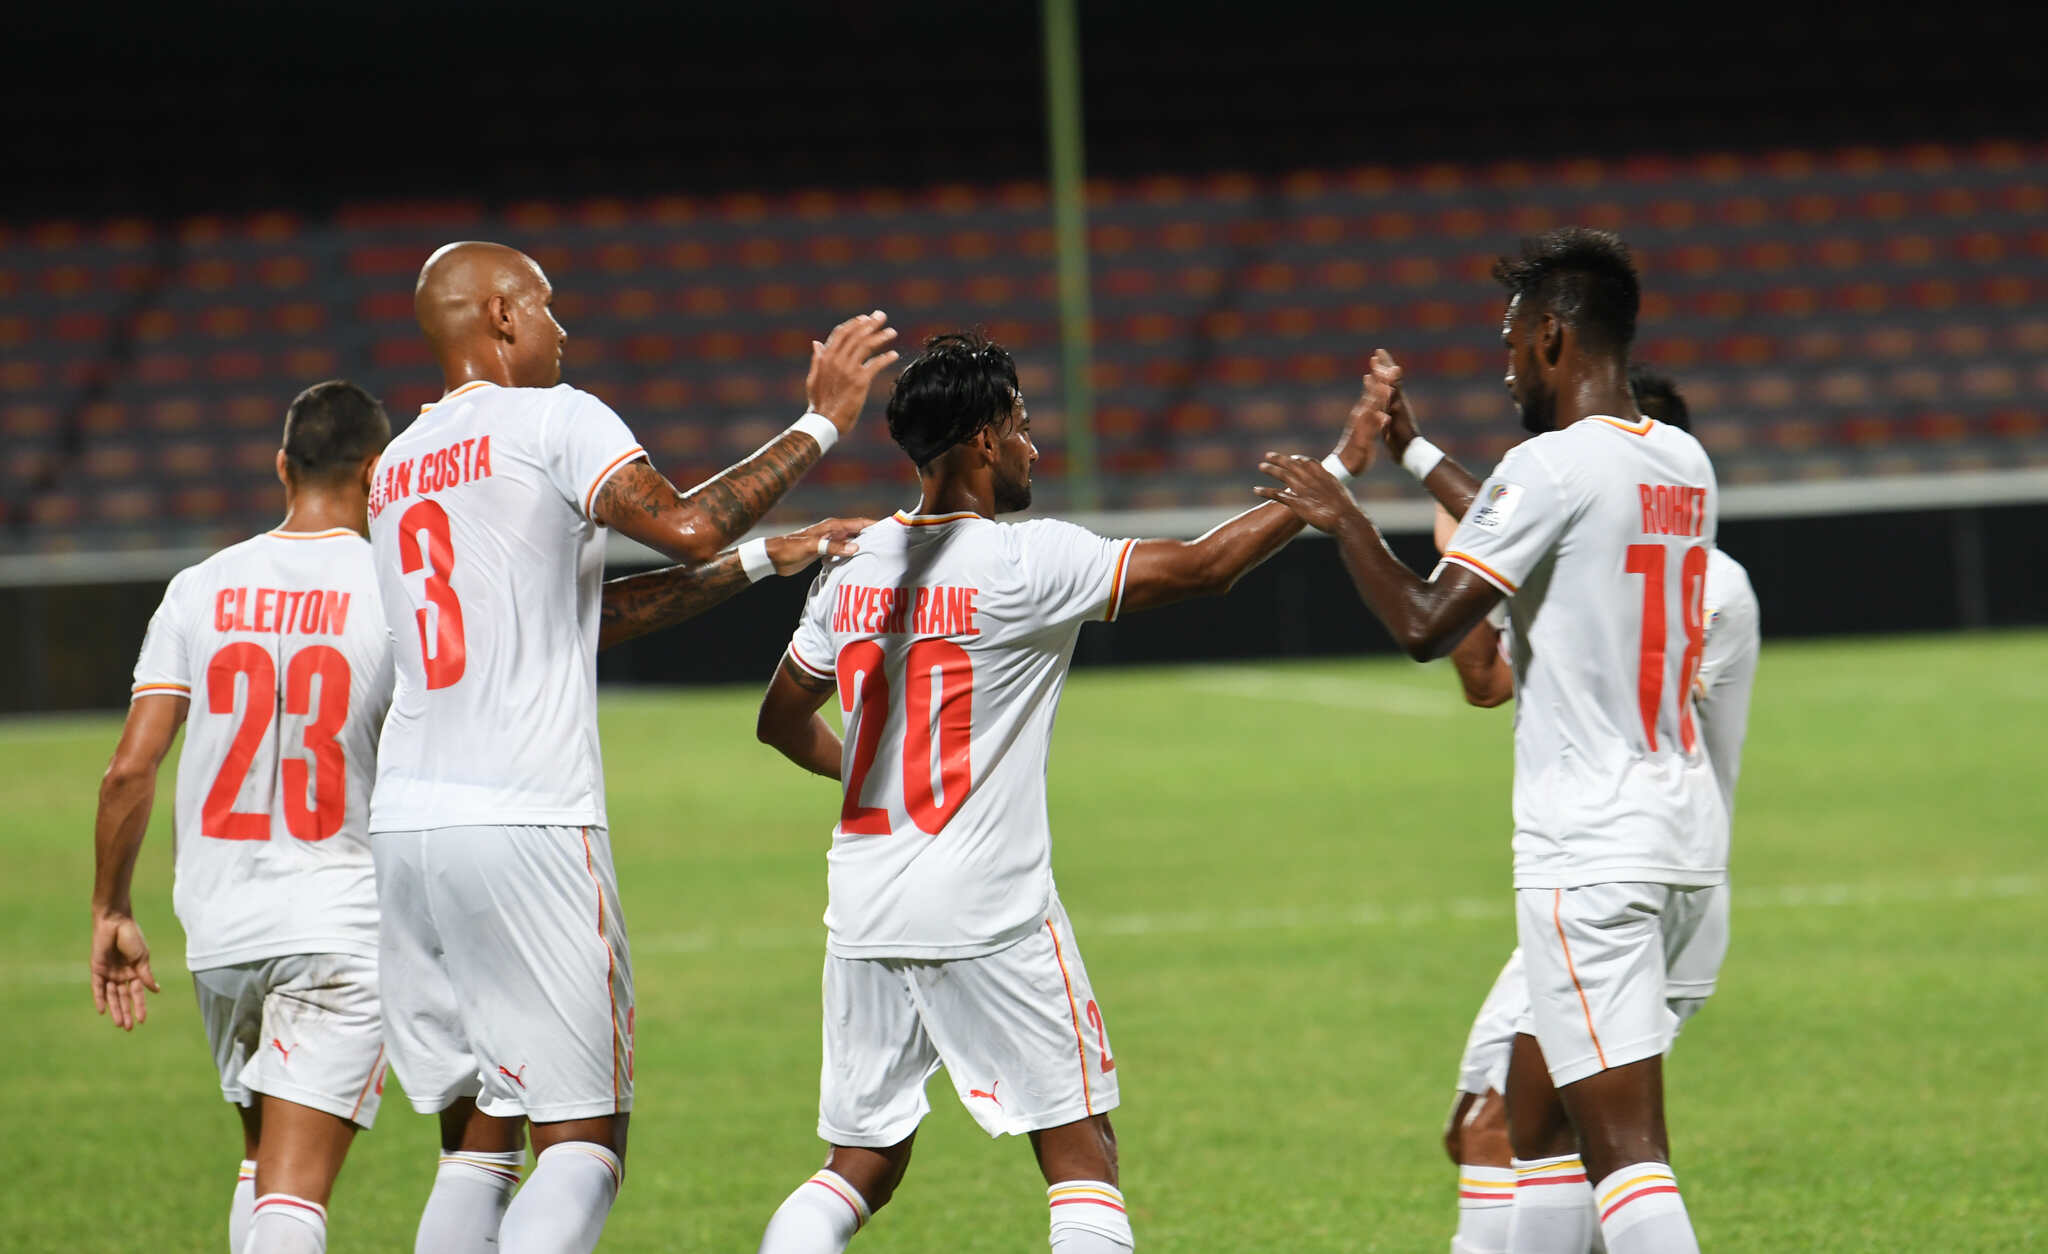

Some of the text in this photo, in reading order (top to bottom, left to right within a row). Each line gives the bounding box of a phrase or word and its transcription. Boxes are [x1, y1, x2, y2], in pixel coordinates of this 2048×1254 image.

[417, 435, 492, 494] COSTA
[1638, 484, 1707, 536] ROHIT
[214, 587, 351, 636] CLEITON
[399, 500, 466, 690] 3
[833, 584, 980, 635] JAYESH RANE
[1625, 544, 1706, 754] 18
[201, 641, 351, 842] 23
[836, 638, 973, 835] 20
